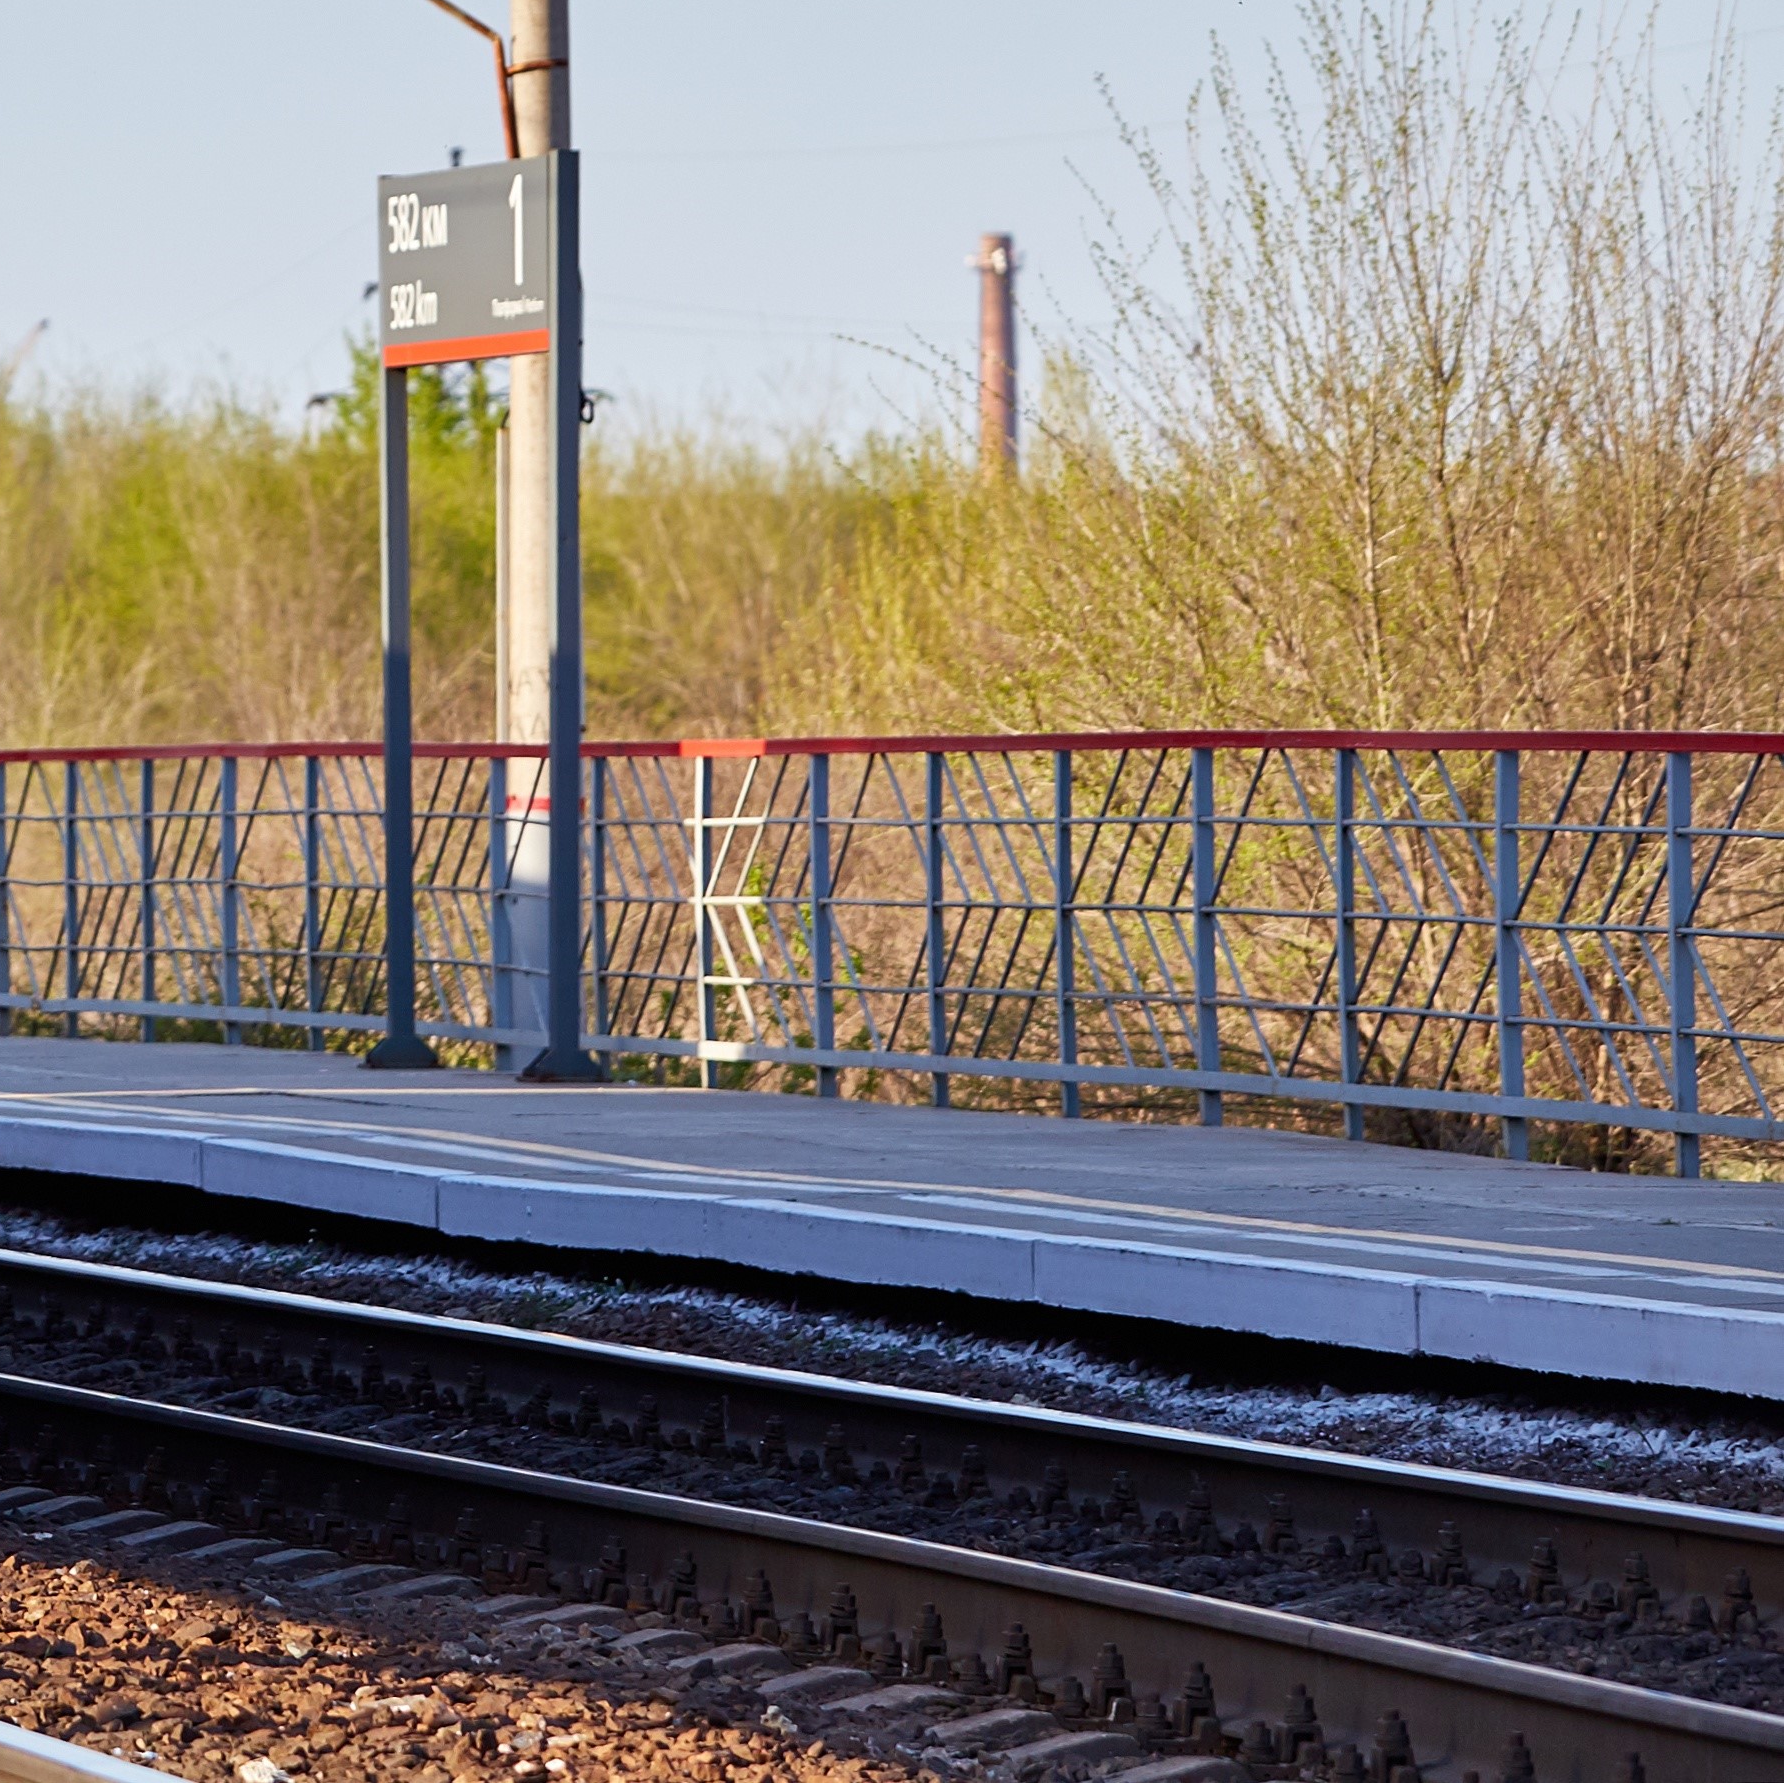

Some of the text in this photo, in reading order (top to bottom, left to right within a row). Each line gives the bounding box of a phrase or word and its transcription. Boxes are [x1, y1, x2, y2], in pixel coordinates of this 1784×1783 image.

[388, 193, 420, 253] 582
[509, 173, 523, 286] 1
[390, 283, 415, 329] 582
[415, 279, 438, 326] km
